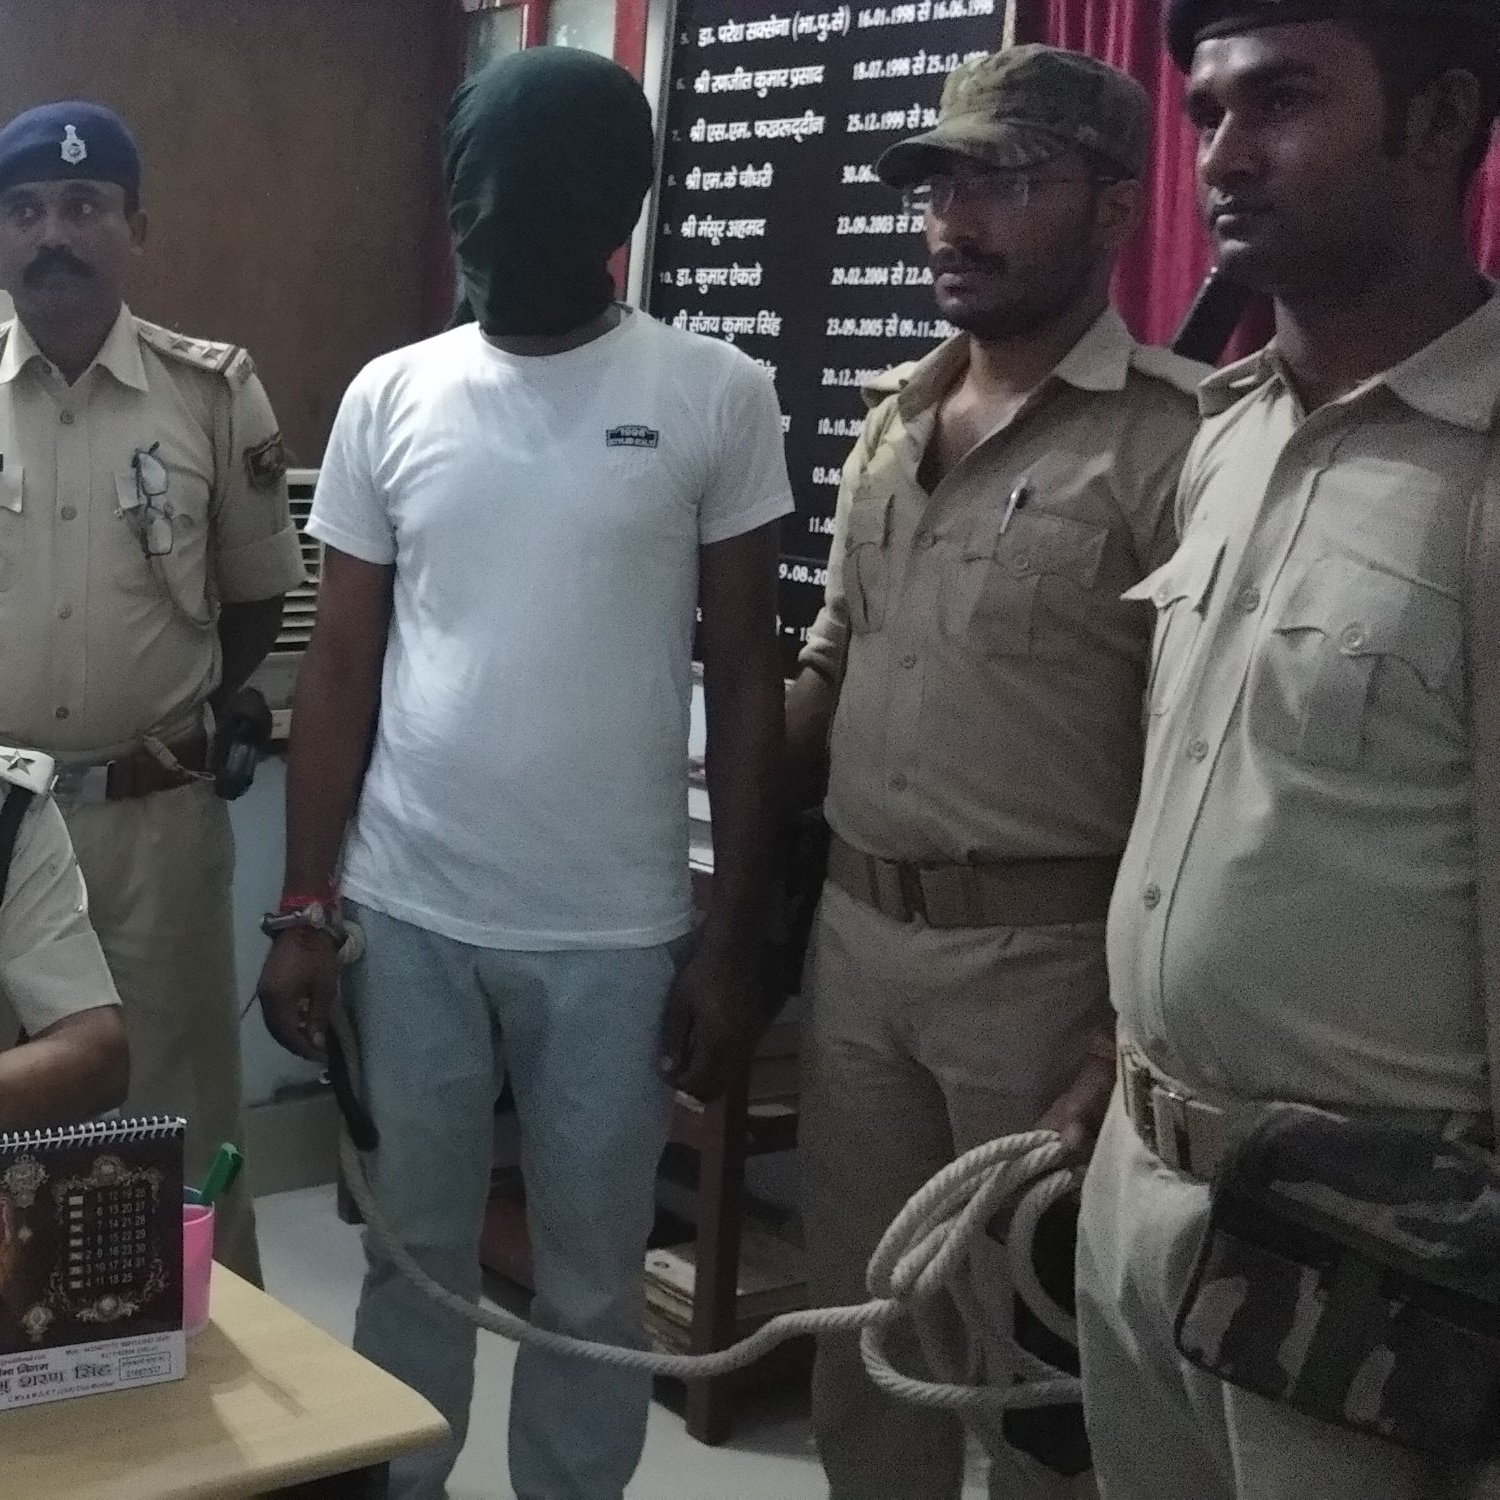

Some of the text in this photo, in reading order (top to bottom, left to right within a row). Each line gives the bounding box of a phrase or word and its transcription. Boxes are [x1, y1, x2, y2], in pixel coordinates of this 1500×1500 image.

[694, 69, 710, 93] श्री
[754, 68, 789, 98] कुमार
[790, 65, 825, 89] प्रसाद
[912, 49, 926, 76] से
[689, 117, 706, 142] श्री
[907, 102, 921, 130] से
[686, 166, 701, 190] श्री
[681, 214, 697, 238] श्री
[726, 219, 766, 239] अहमद
[695, 268, 728, 294] कुमार
[891, 260, 904, 285] से
[721, 316, 756, 343] कुमार
[757, 310, 782, 337] सिंह
[884, 312, 898, 337] से
